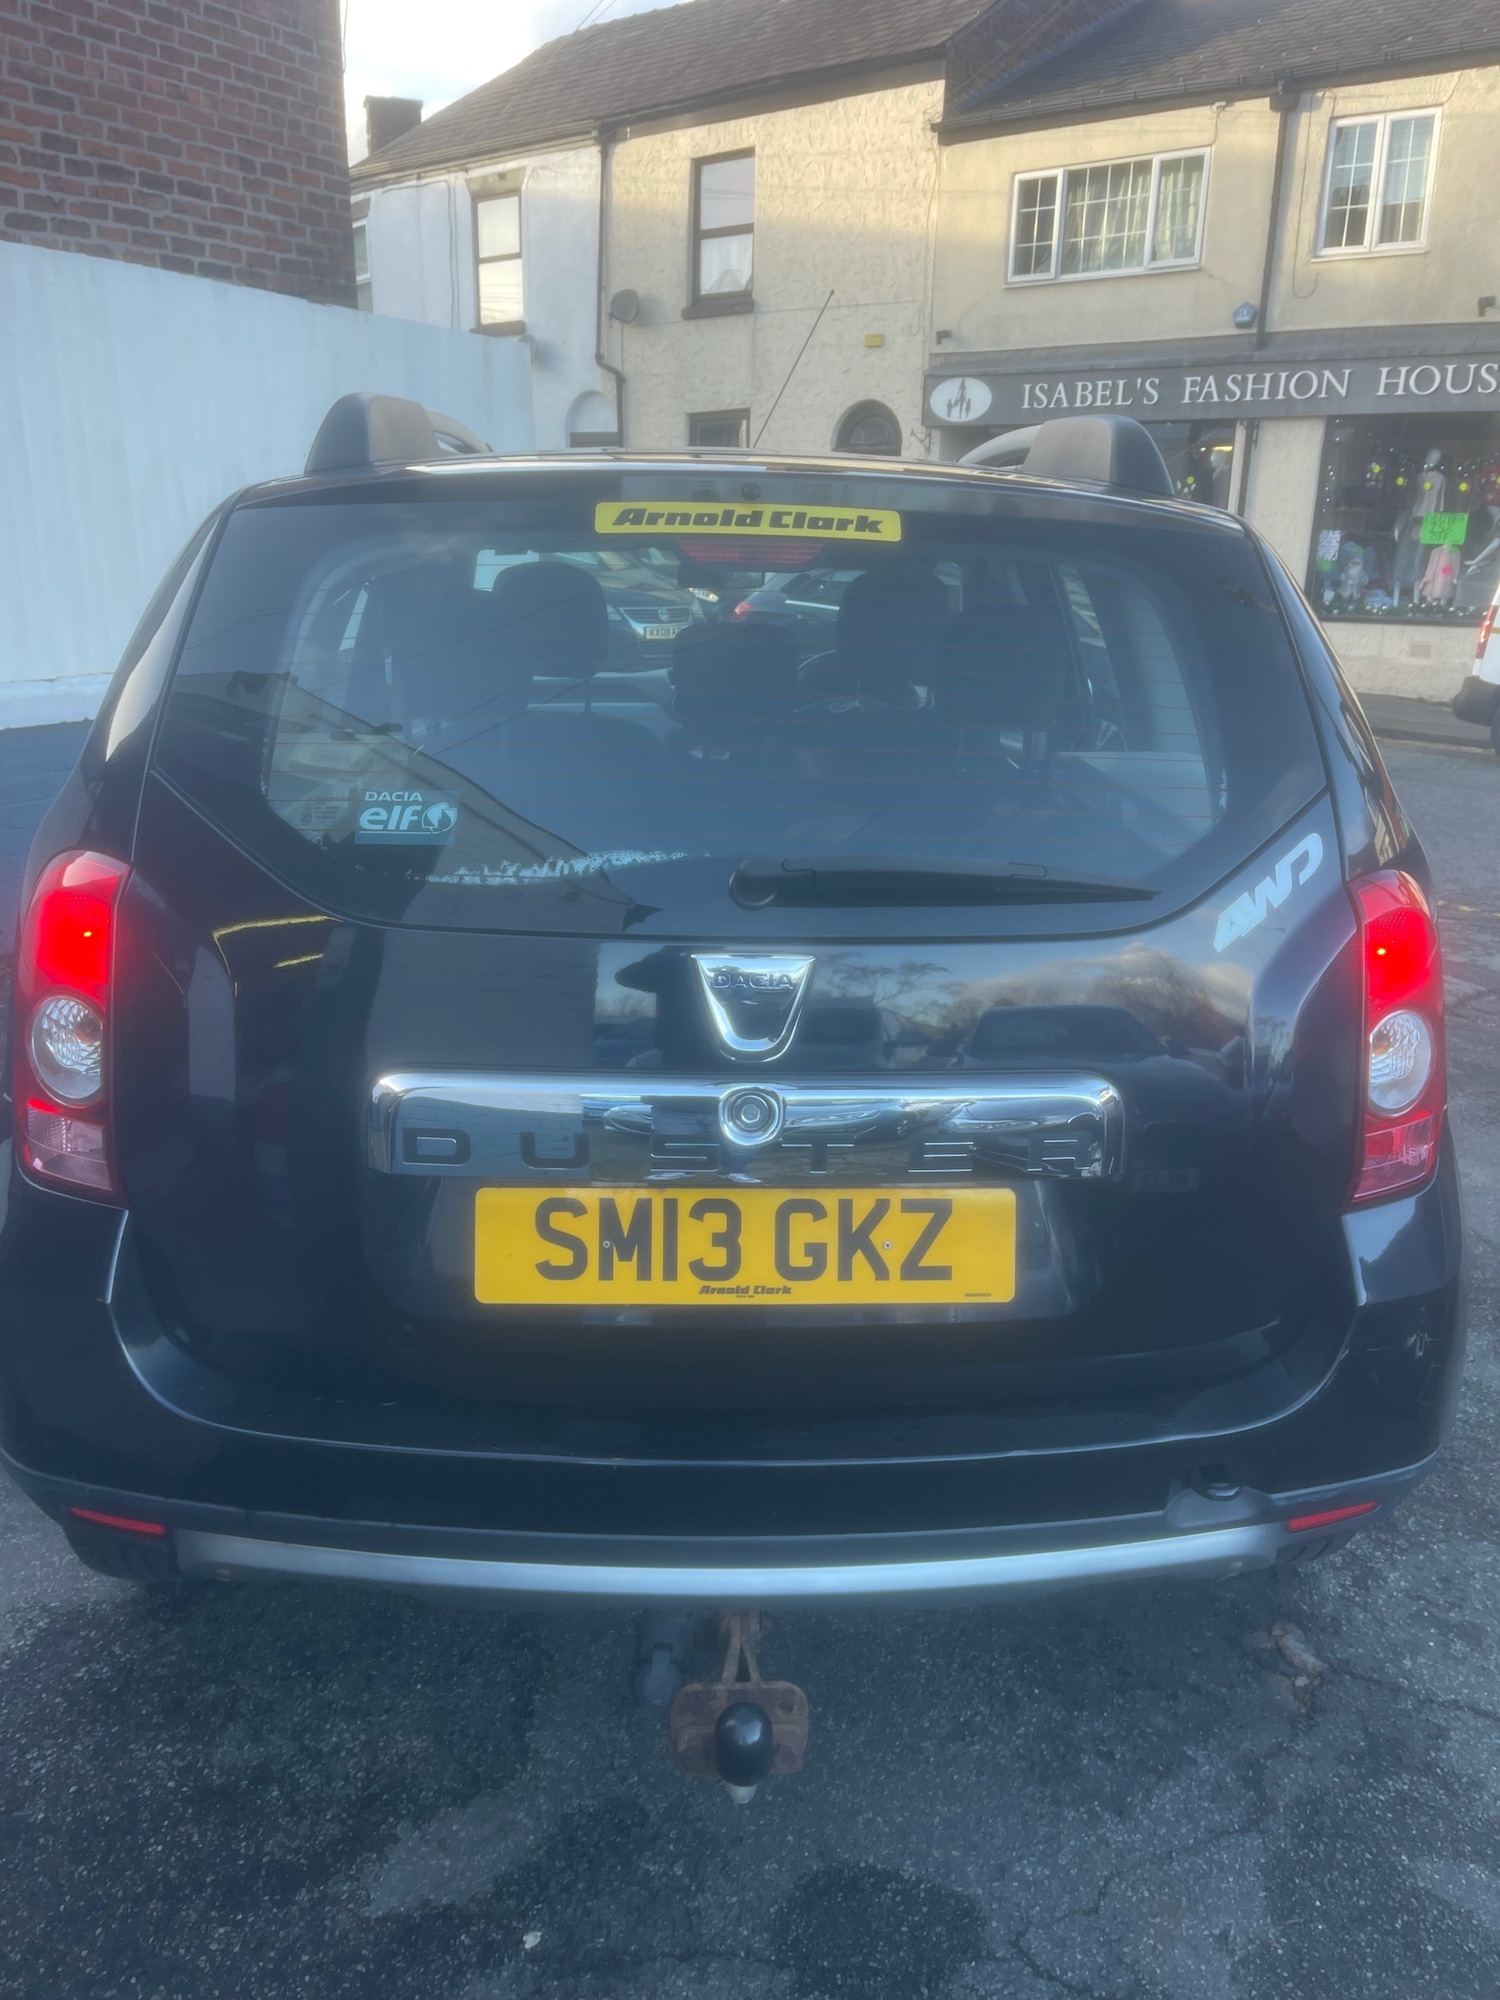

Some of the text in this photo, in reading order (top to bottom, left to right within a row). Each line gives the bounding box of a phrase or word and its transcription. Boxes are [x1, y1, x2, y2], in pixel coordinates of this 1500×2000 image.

[1021, 362, 1500, 409] ISABEL'S FASHION HOUS
[612, 507, 884, 535] Arnold Clark
[365, 791, 423, 802] DACIA
[359, 804, 423, 831] elf
[712, 970, 794, 990] DACIA
[402, 1127, 1092, 1175] DUSTER
[534, 1197, 953, 1282] SM13 GKZ
[698, 1285, 792, 1295] Arnold Clark
